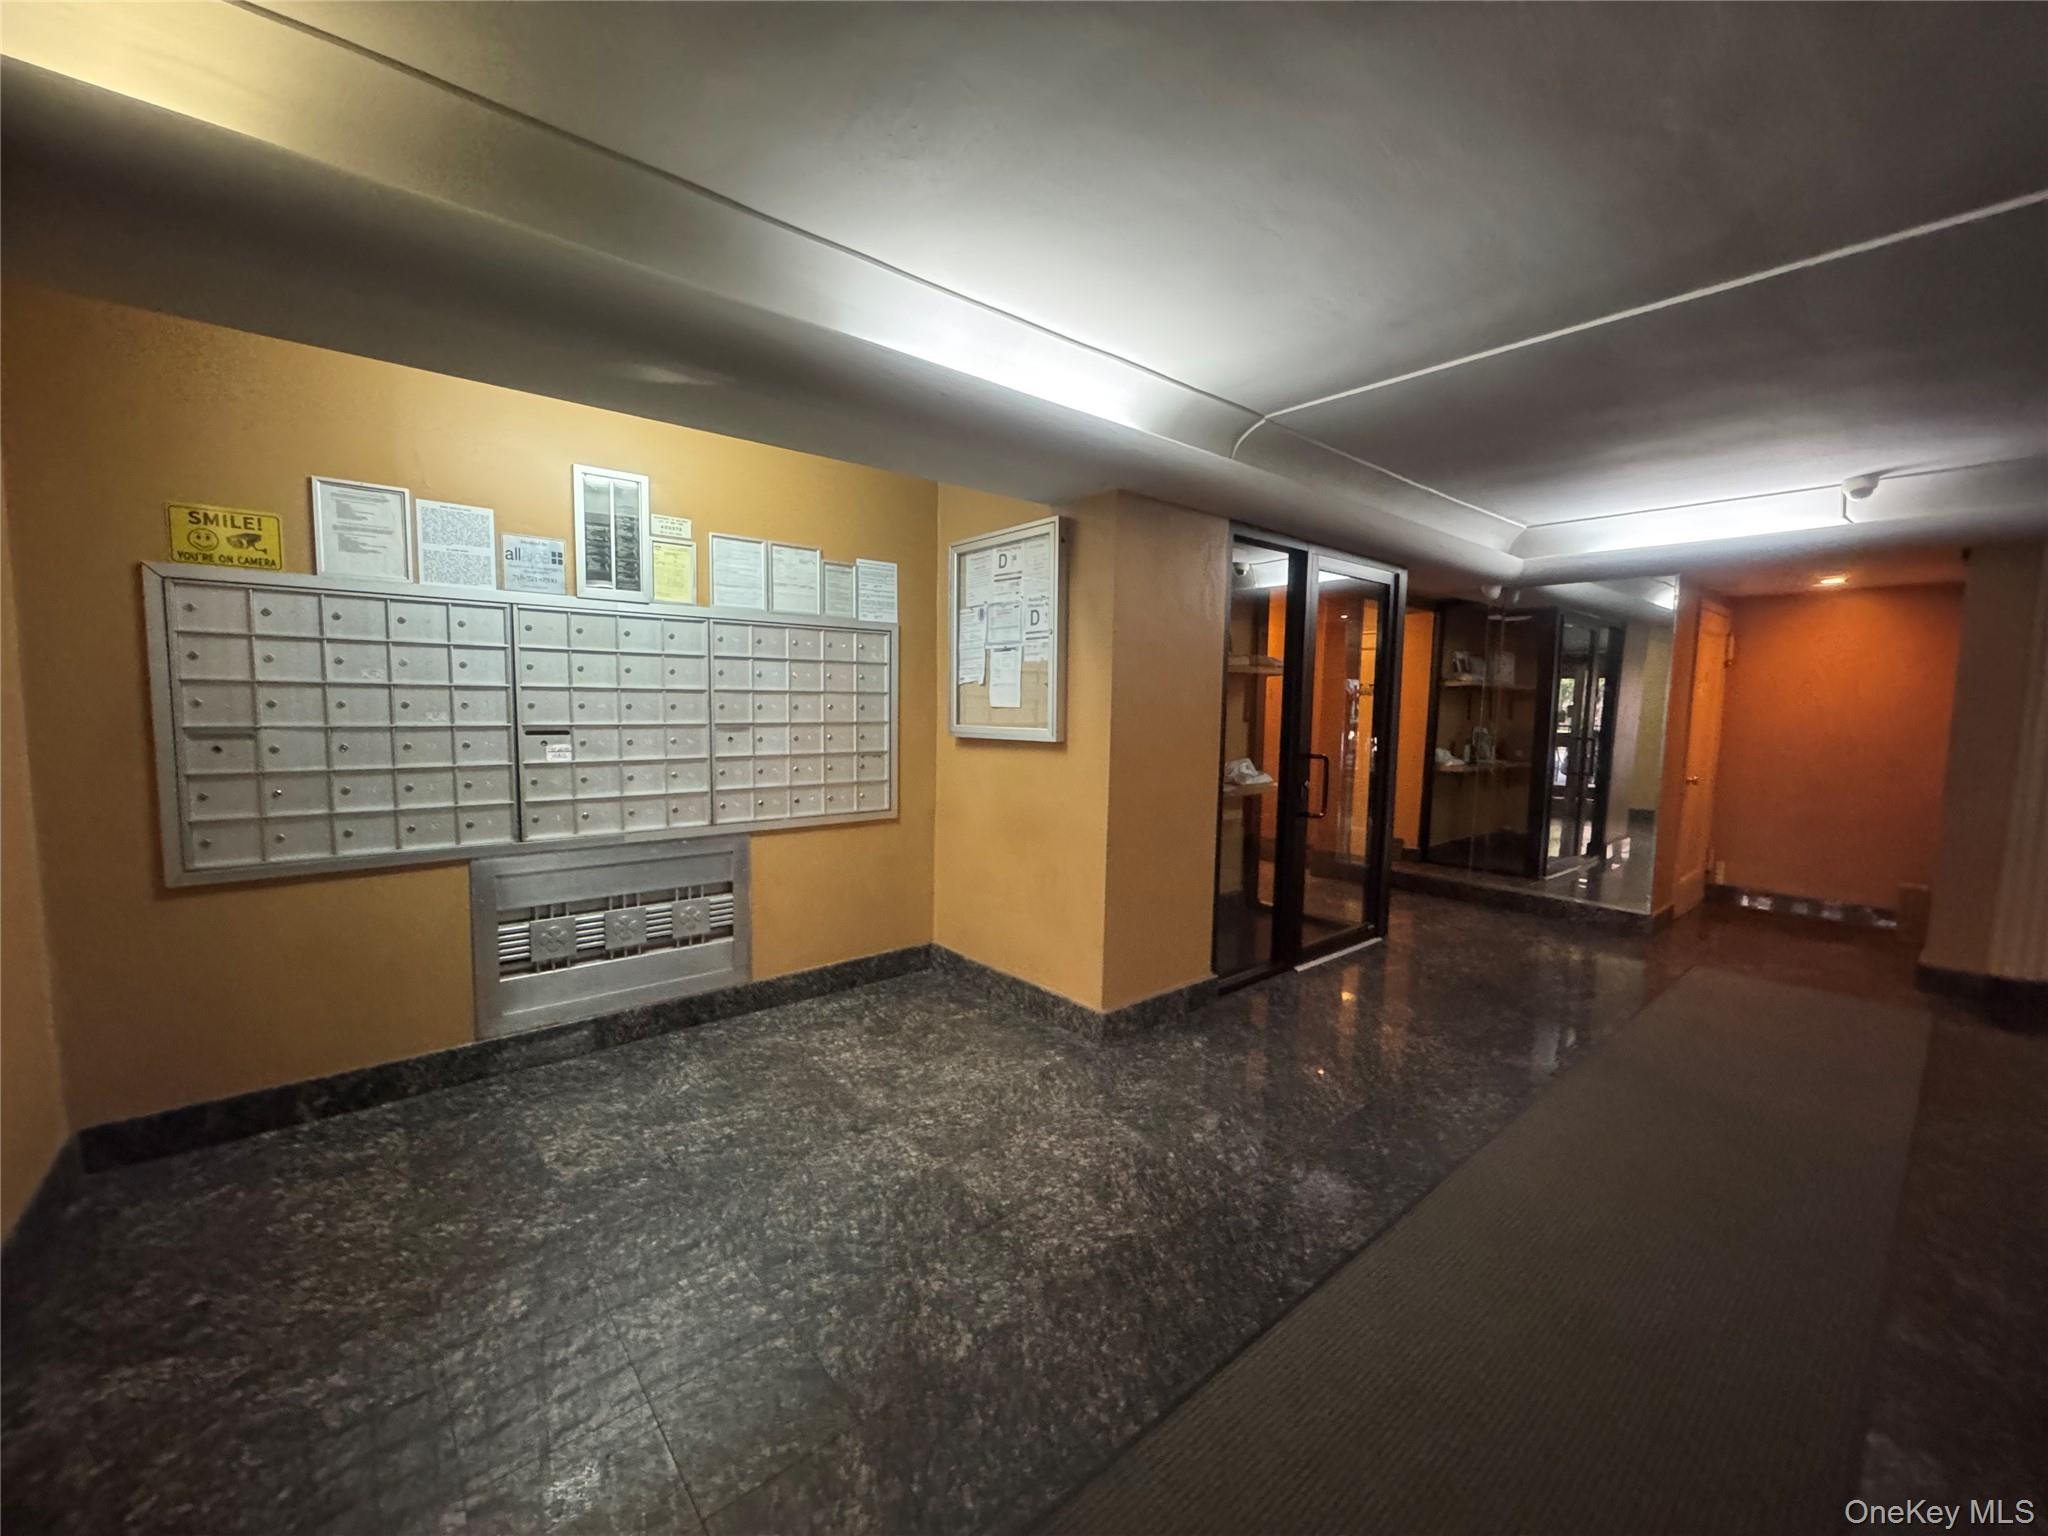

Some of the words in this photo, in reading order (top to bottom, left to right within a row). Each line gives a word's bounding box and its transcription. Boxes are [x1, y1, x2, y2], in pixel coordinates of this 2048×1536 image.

[188, 510, 262, 531] SMILE!
[177, 550, 215, 562] YOU'RE
[218, 555, 233, 563] ON
[237, 556, 276, 567] CAMERA
[999, 553, 1008, 569] D
[1030, 609, 1040, 626] D
